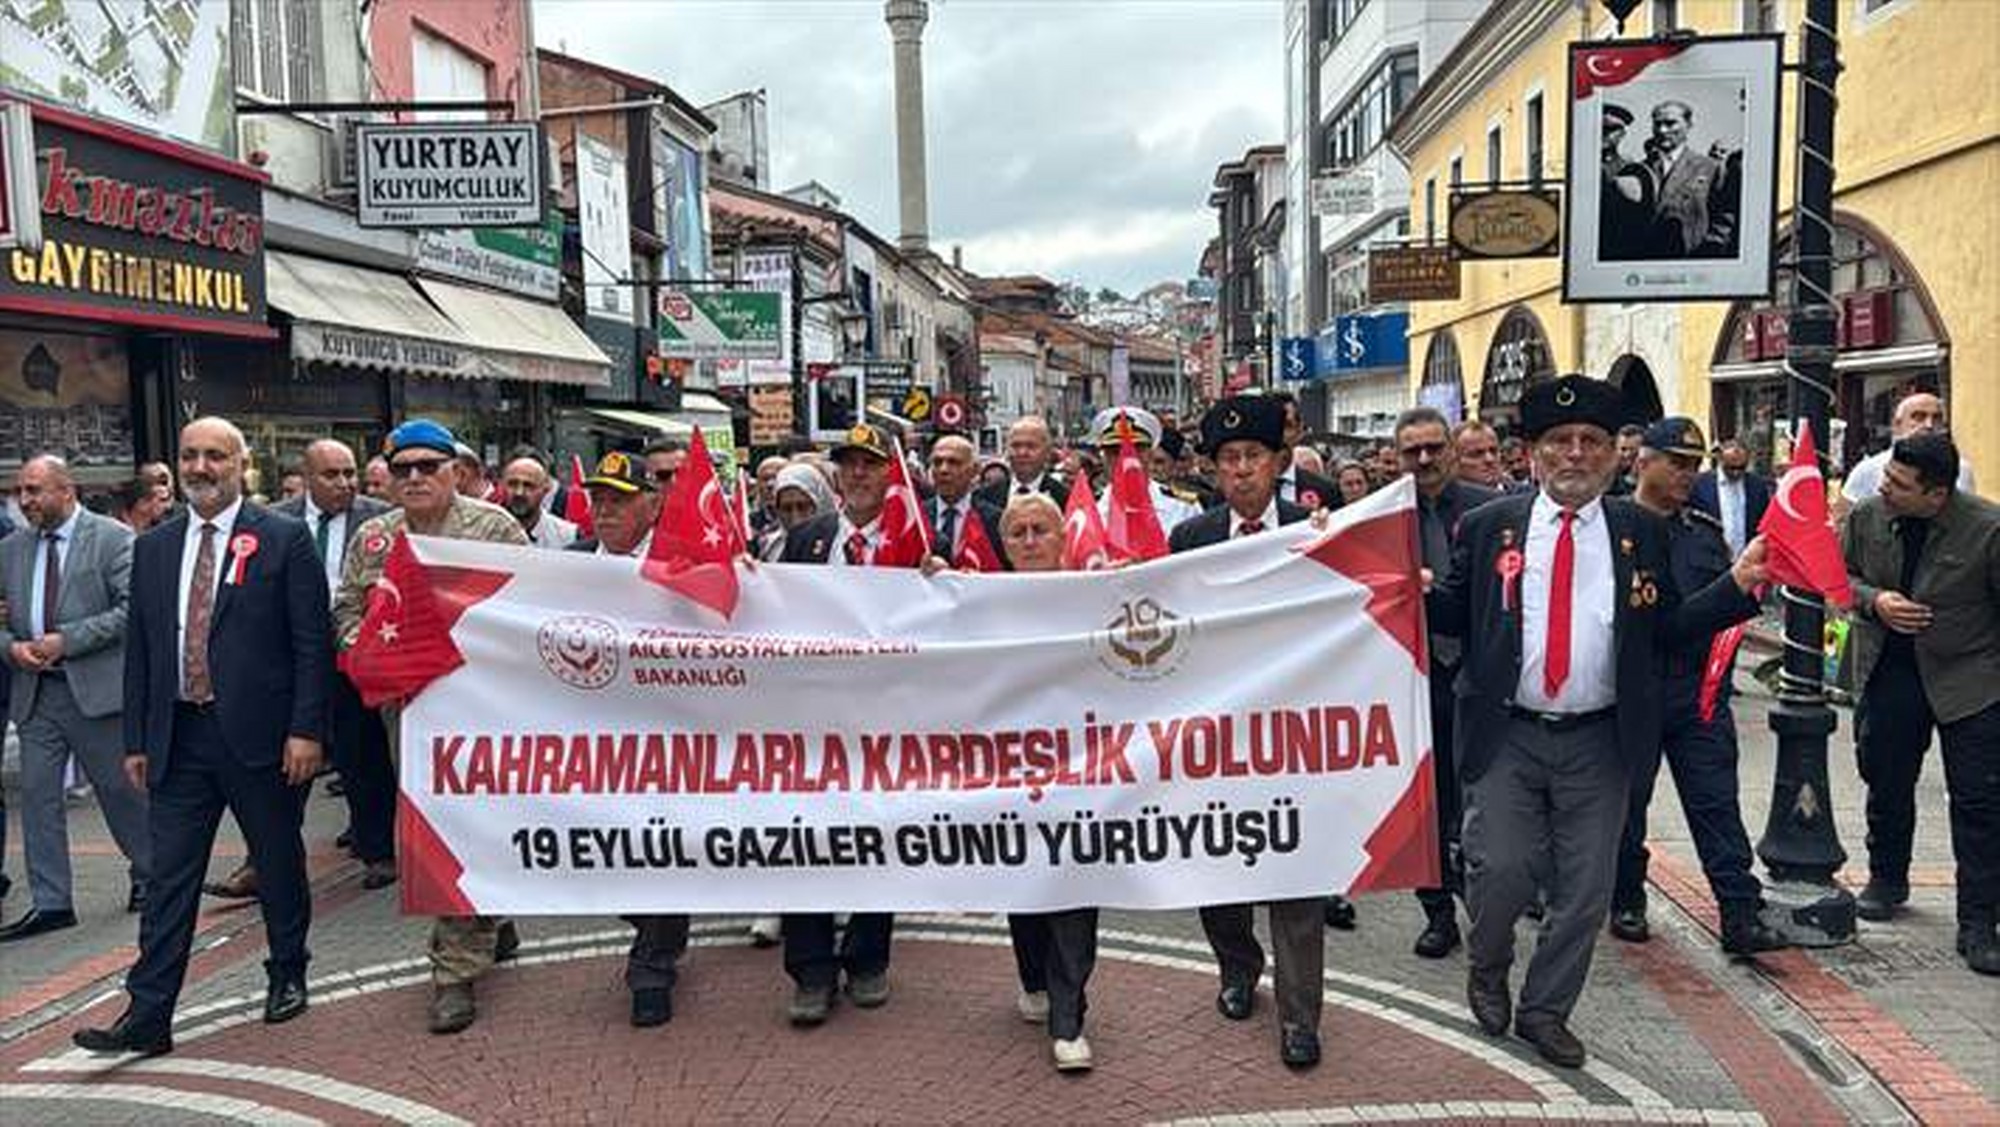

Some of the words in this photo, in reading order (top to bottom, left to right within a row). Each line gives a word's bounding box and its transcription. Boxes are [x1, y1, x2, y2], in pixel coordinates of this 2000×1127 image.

[372, 136, 523, 169] YURTBAY
[372, 177, 526, 200] KUYUMCULUK
[458, 210, 518, 221] YURTBAY
[11, 239, 250, 313] GAYRİMENKUL
[321, 331, 398, 362] KUYUMCU
[678, 641, 703, 660] VE
[634, 664, 747, 687] BAKANLIĞI
[431, 733, 851, 797] KAHRAMANLARLA
[860, 711, 1138, 803] KARDEŞLİK
[1147, 703, 1401, 782] YOLUNDA
[512, 827, 559, 869] 19
[569, 817, 698, 869] EYLÜL
[704, 815, 885, 868] GAZİLER
[898, 813, 1028, 867] GÜNÜ
[1038, 798, 1301, 867] YÜRÜYÜŞÜ
